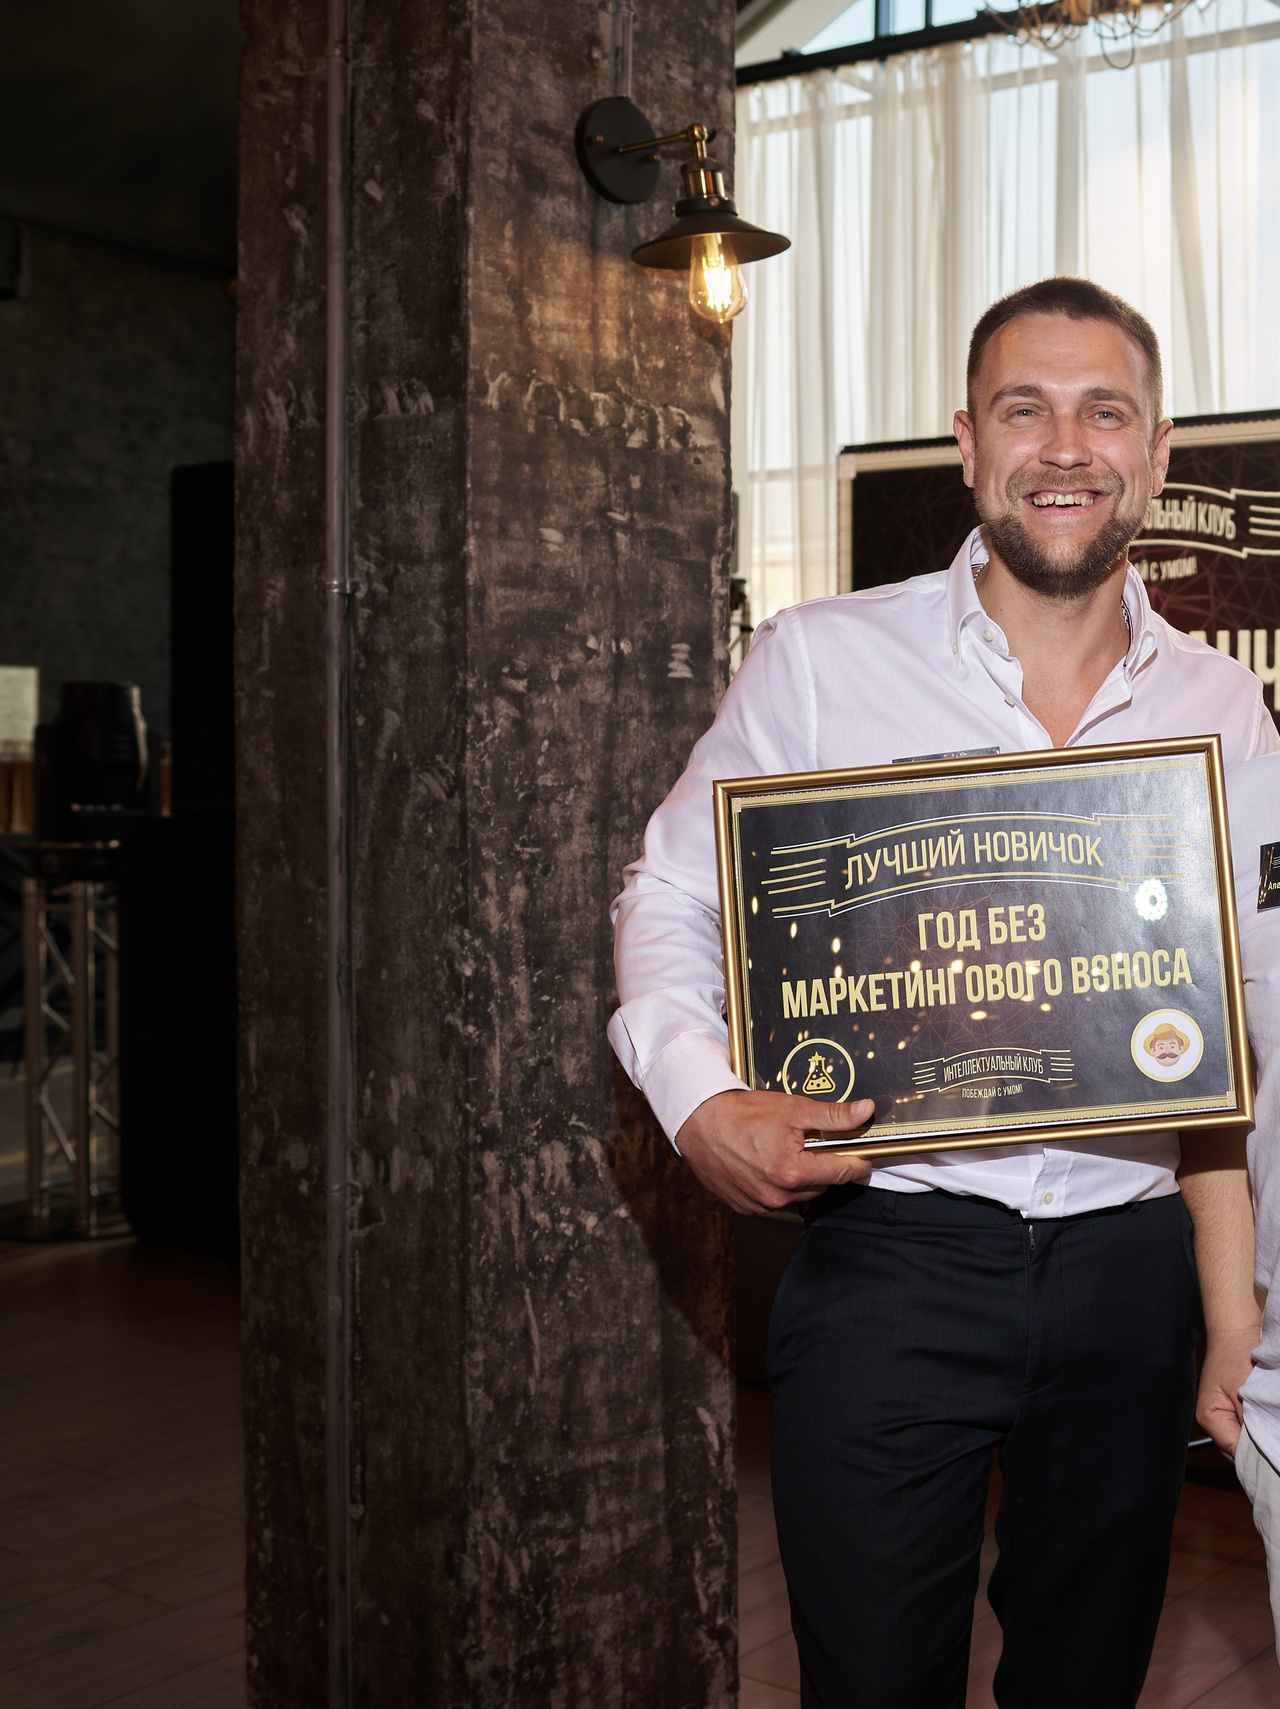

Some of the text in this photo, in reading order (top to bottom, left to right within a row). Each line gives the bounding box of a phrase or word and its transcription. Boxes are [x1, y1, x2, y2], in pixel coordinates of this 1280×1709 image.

[1198, 501, 1236, 540] КЛУБ
[845, 828, 1104, 890] ЛУЧШИЙ НОВИЧОК
[918, 903, 1047, 953] ГОД БЕЗ
[781, 948, 1193, 1019] МАРКЕТИНГОВОГО ВЗНОСА
[943, 1053, 1044, 1083] ИНТЕЛЛЕКТУАЛЬНЫЙ КЛУБ
[962, 1086, 997, 1099] ПОБЕЖДАЙ
[1003, 1084, 1023, 1096] УМОМ!
